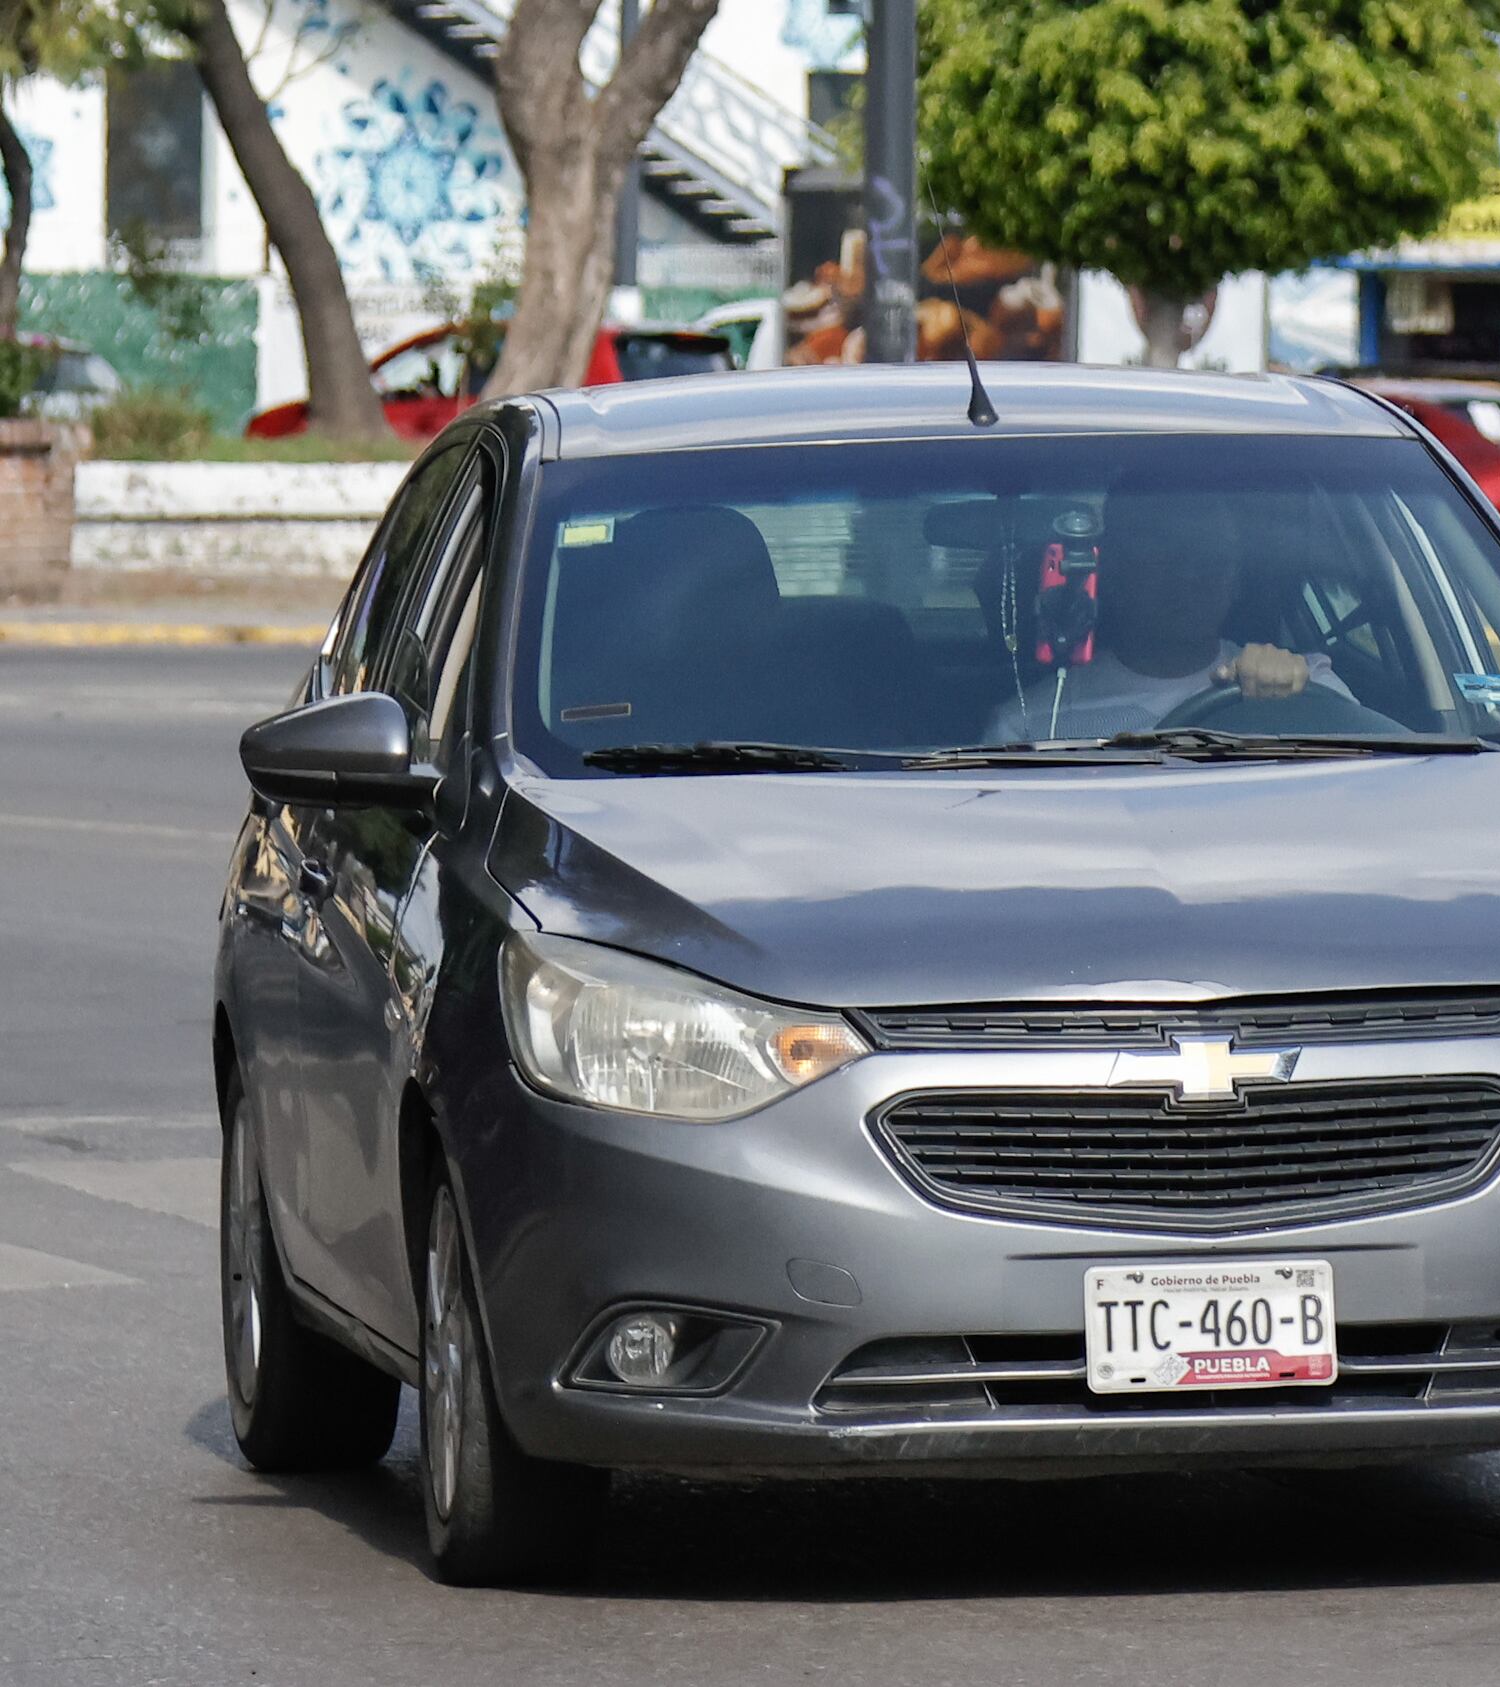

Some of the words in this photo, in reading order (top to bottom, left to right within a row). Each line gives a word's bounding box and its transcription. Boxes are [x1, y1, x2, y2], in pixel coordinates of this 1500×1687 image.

[1096, 1279, 1105, 1290] F
[1151, 1276, 1203, 1287] Gobierno
[1205, 1276, 1218, 1285] de
[1222, 1274, 1260, 1285] Puebla
[1097, 1294, 1324, 1352] TTC-460-B
[1194, 1356, 1271, 1374] PUEBLA
